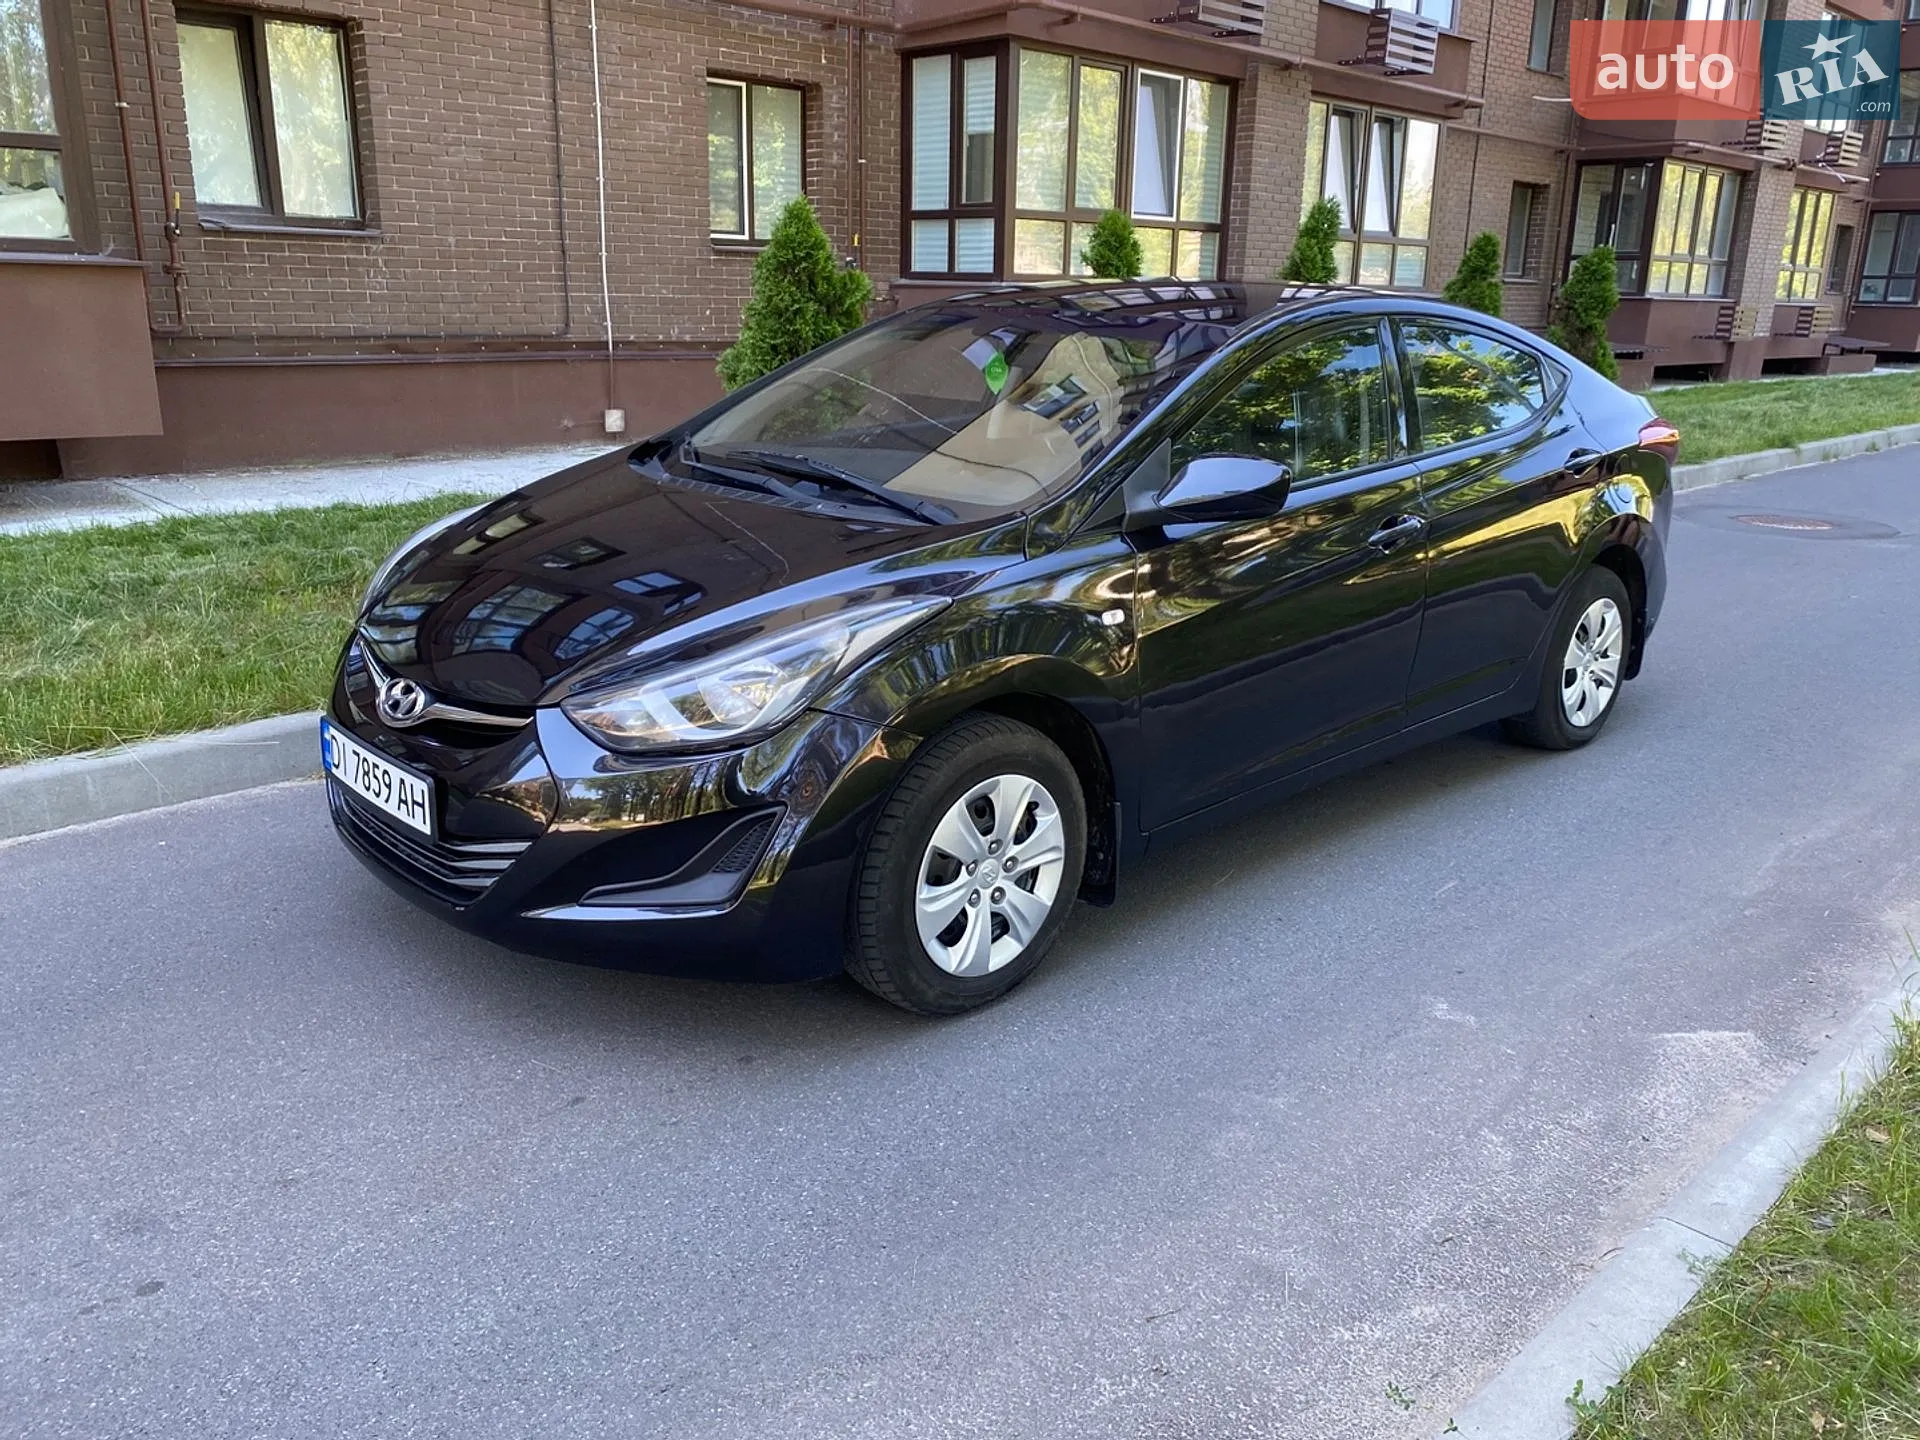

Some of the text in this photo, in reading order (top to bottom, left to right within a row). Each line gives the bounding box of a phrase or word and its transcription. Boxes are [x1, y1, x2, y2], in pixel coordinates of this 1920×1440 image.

[330, 734, 427, 826] DI 7859 AH
